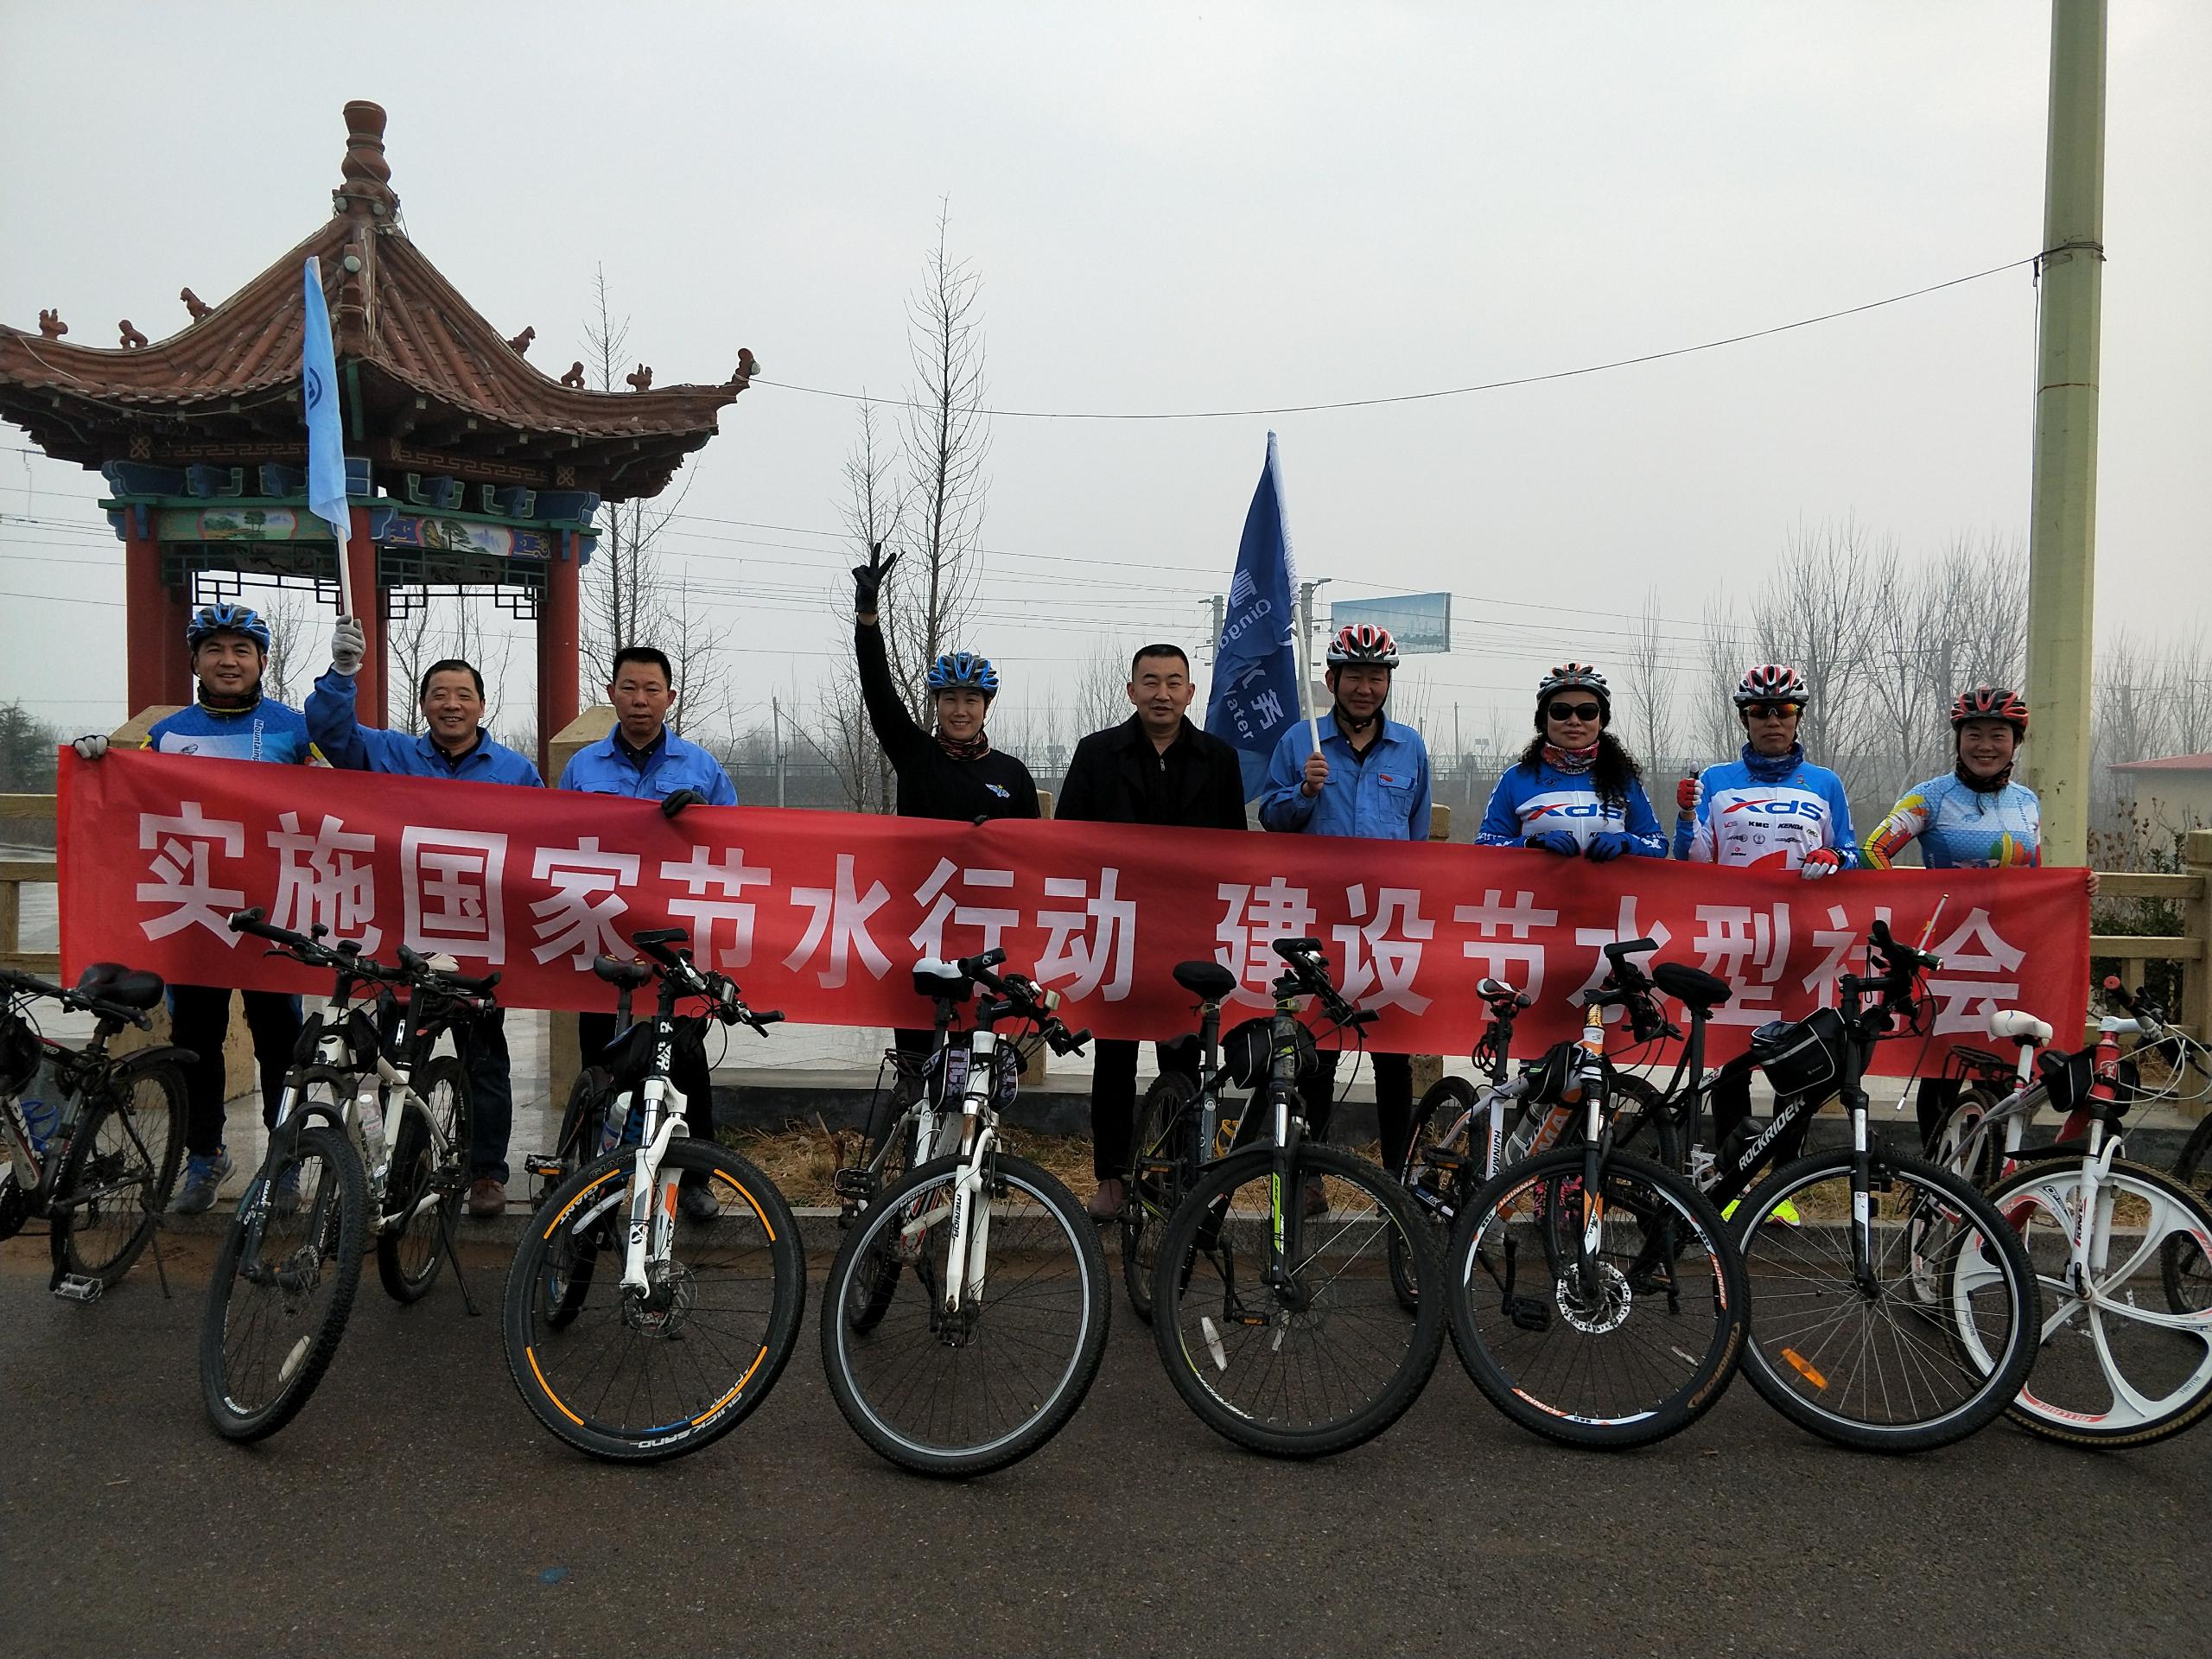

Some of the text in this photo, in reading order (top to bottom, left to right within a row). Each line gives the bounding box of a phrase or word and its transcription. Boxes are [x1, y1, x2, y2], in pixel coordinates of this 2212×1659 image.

[1224, 690, 1254, 740] ater
[1777, 823, 1803, 831] KENDA
[137, 801, 1137, 1003] 实施国家节水行动
[1492, 1129, 1502, 1175] HJINMA
[1738, 1095, 1805, 1173] ROCKRIDER
[952, 1193, 962, 1238] MERIDA
[1498, 1179, 1535, 1206] HJINMA
